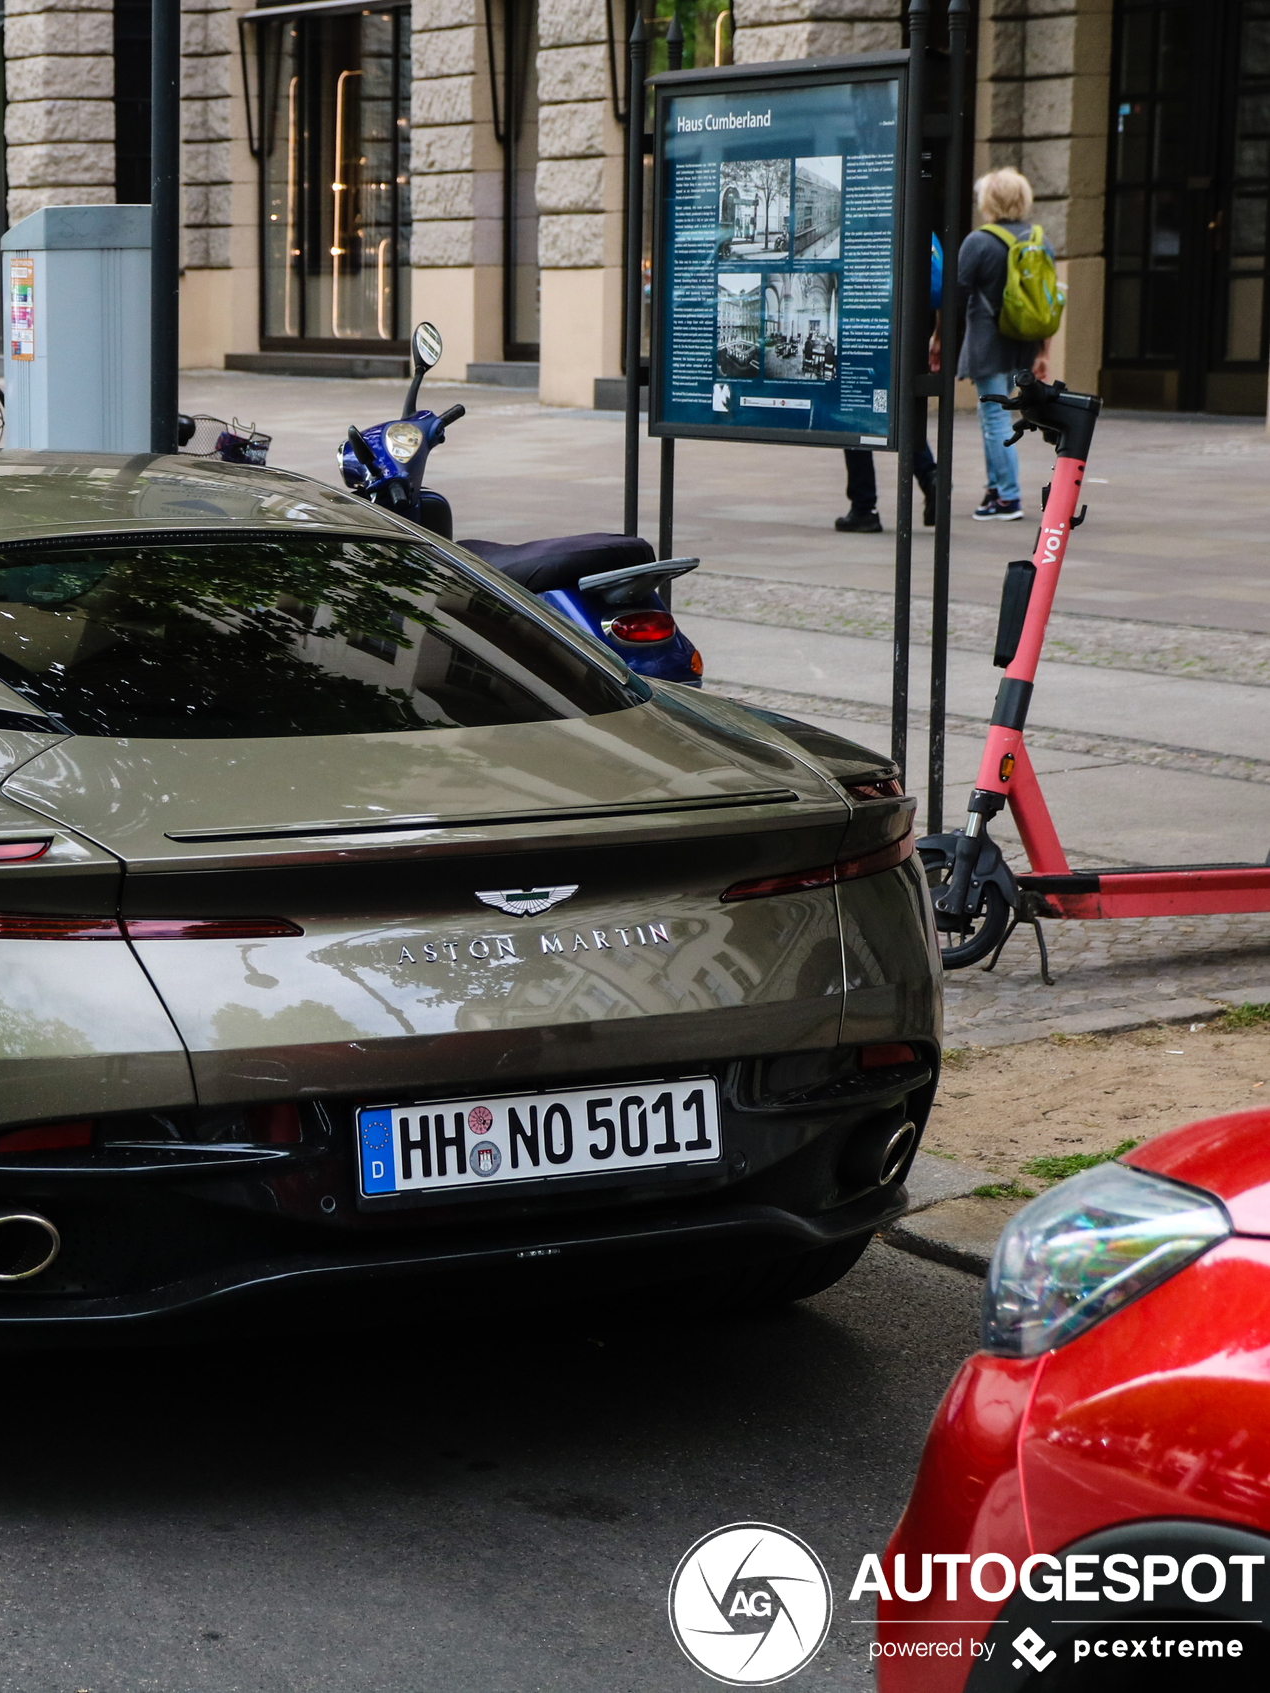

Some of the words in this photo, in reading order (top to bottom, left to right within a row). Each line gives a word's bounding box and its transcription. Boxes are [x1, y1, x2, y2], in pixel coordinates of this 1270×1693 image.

[677, 116, 703, 132] Haus
[705, 109, 771, 131] Cumberland
[1041, 522, 1065, 564] voi.
[397, 937, 517, 966] ASTON
[541, 923, 670, 955] MARTIN
[399, 1111, 467, 1180] HH
[508, 1103, 573, 1169] NO
[587, 1088, 712, 1160] 5011
[371, 1160, 384, 1179] D
